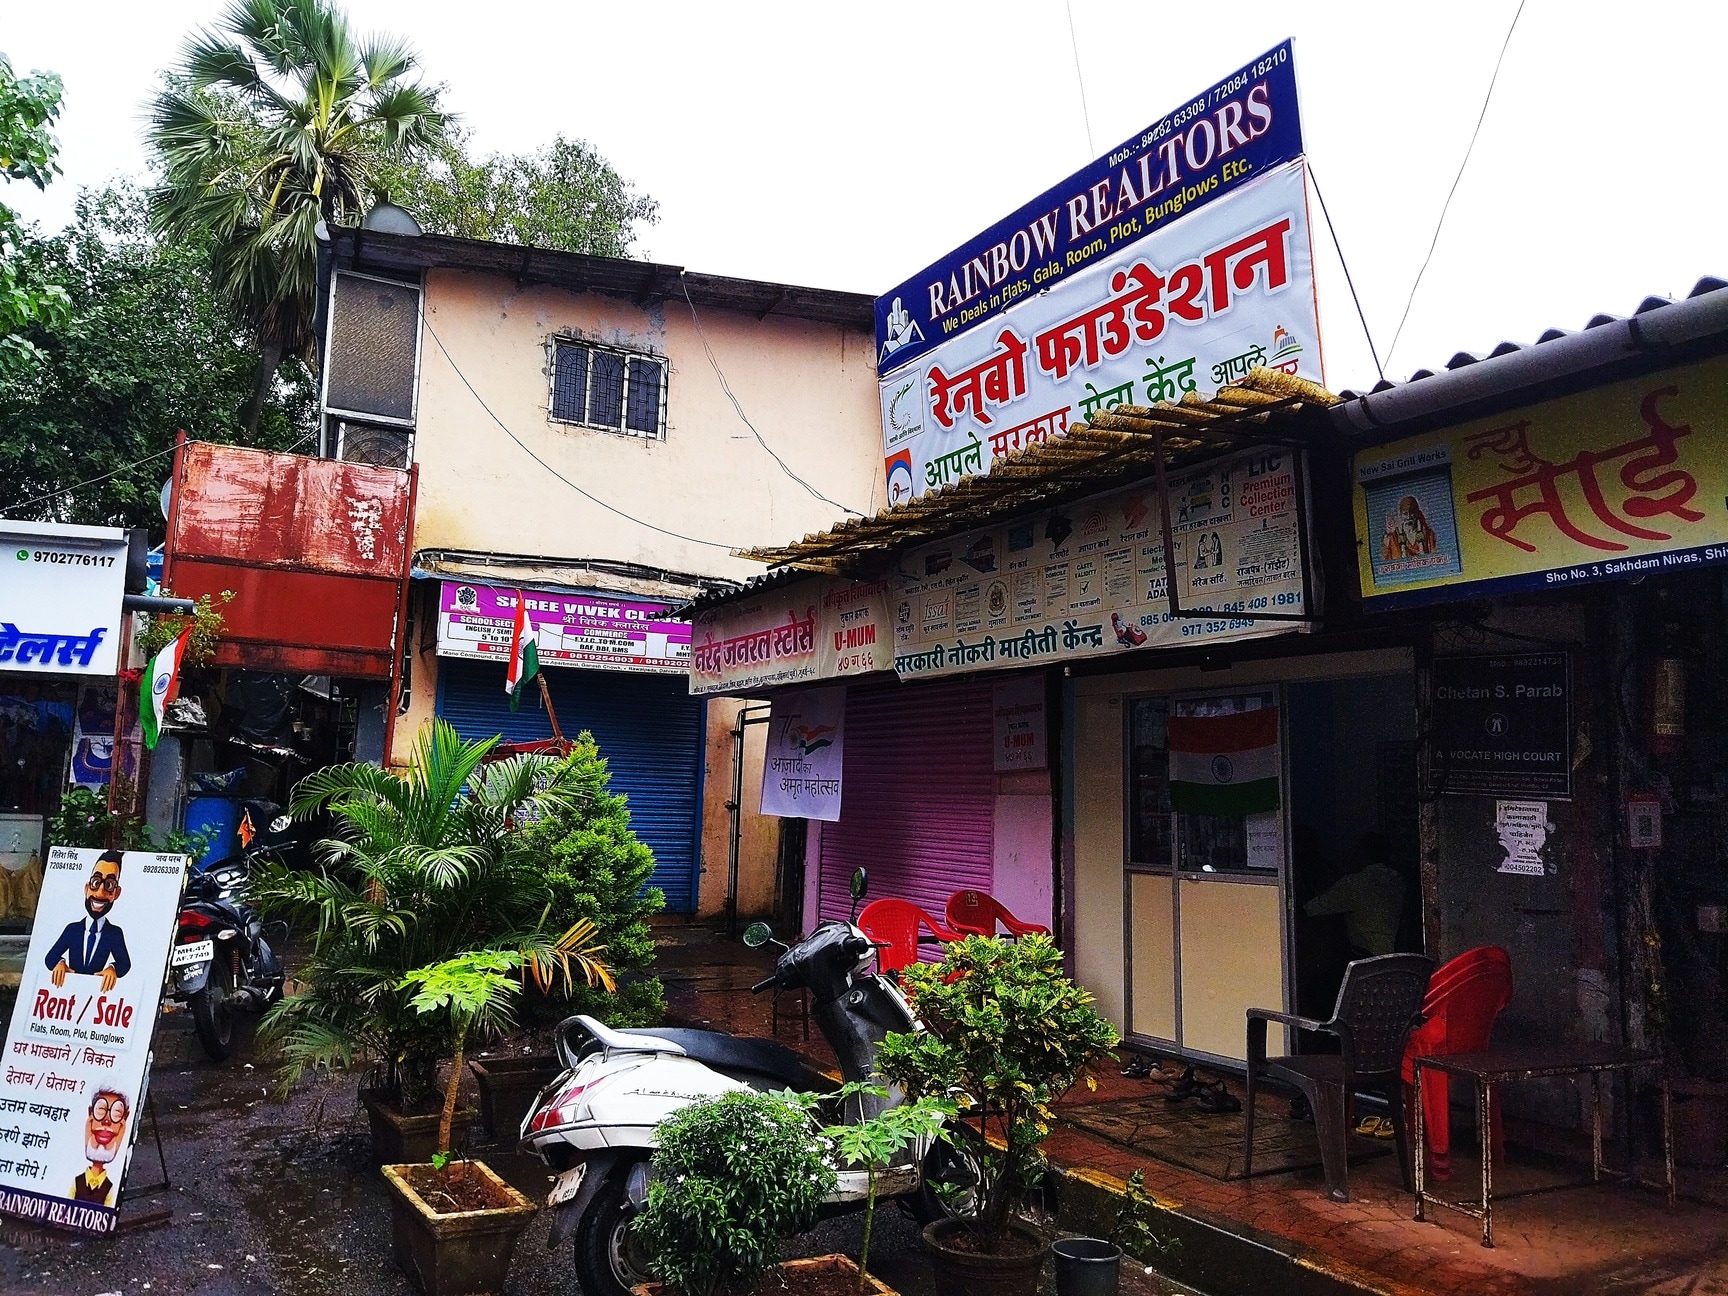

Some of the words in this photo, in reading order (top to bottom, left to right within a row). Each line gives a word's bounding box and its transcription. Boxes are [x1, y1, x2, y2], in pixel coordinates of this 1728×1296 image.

[1141, 120, 1172, 148] 89282
[1174, 98, 1206, 129] 63308
[1207, 94, 1213, 109] /
[1214, 72, 1249, 104] 72084
[1251, 48, 1288, 79] 18210
[928, 208, 1060, 321] RAINBOW
[1066, 82, 1274, 243] REALTORS
[942, 318, 959, 334] We
[961, 303, 988, 325] Deals
[990, 294, 1001, 309] in
[1002, 279, 1032, 304] Flats,
[1033, 261, 1065, 286] Gala,
[1066, 238, 1108, 267] Room,
[1110, 218, 1143, 244] Plot,
[1145, 173, 1219, 225] Bunglows
[1222, 156, 1253, 181] Etc.
[1036, 218, 1290, 377] फाउंडेशन
[925, 431, 983, 487] आपले
[1248, 453, 1282, 478] LIC
[1360, 466, 1380, 477] New
[1380, 461, 1396, 472] Sai
[1397, 454, 1416, 469] Grill
[1417, 449, 1448, 464] Works
[1466, 384, 1706, 553] साई
[1243, 473, 1291, 494] Premium
[1240, 485, 1295, 507] Collection
[1250, 500, 1286, 517] Center
[1142, 541, 1182, 556] Electrty
[33, 550, 116, 568] 9702776117
[1076, 561, 1093, 571] CASTE
[1546, 569, 1568, 583] Sho
[1571, 569, 1590, 580] No.
[1592, 566, 1603, 577] 3,
[1605, 556, 1660, 575] Sakhdam
[1663, 552, 1703, 567] Nivas,
[1074, 569, 1097, 579] VALIDITY
[1149, 577, 1169, 589] TAT
[1147, 587, 1169, 601] ADA
[1224, 602, 1245, 613] 845
[1248, 597, 1268, 609] 408
[1271, 591, 1301, 606] 1981
[563, 602, 621, 619] VIVEK
[1014, 612, 1042, 622] EMPLOYMENT
[460, 615, 496, 626] SCHOOL
[562, 614, 577, 625] श्री
[579, 616, 609, 628] विवेक
[611, 620, 649, 631] क्लासेस
[840, 611, 854, 629] दुकान
[1140, 614, 1160, 627] 885
[1182, 624, 1202, 636] 977
[1206, 620, 1226, 633] 352
[465, 625, 492, 634] ENGLISH
[496, 628, 512, 636] SEMI
[583, 628, 628, 639] COMMERCE
[694, 630, 722, 673] नरेंद्र
[723, 629, 772, 666] जनरल
[773, 604, 817, 657] स्टोर्स
[834, 623, 876, 651] U-MUM
[569, 652, 634, 664] 9819254903
[612, 646, 629, 654] BMS
[895, 643, 945, 675] सरकारी
[947, 635, 996, 667] नोकरी
[999, 625, 1057, 660] माहीती
[1437, 686, 1490, 699] Chetan
[1494, 685, 1510, 698] S.
[1515, 683, 1563, 698] Parab
[1004, 732, 1035, 748] U-MUM
[1493, 751, 1520, 761] HIGH
[1522, 751, 1562, 762] COURT
[803, 763, 813, 774] का
[780, 778, 803, 800] अमृत
[804, 773, 840, 798] महोत्सव
[49, 861, 83, 871] 7208418210
[142, 865, 180, 875] 8928263308
[33, 989, 76, 1021] Rent
[76, 995, 93, 1025] /
[93, 995, 134, 1029] Sale
[30, 1023, 48, 1037] Flats,
[49, 1027, 72, 1040] Room,
[72, 1029, 88, 1041] Plot,
[90, 1032, 125, 1045] Bunglows
[13, 1041, 28, 1057] घर
[71, 1048, 82, 1066] /
[82, 1046, 116, 1069] विकत
[5, 1065, 36, 1087] देताय
[35, 1072, 46, 1090] /
[45, 1072, 78, 1093] घेताय
[79, 1080, 86, 1095] ?
[0, 1098, 28, 1114] उत्तम
[29, 1102, 71, 1122] व्यवहार
[21, 1130, 51, 1149] झाले
[15, 1158, 40, 1179] सोपे
[41, 1164, 48, 1181] !
[47, 1201, 110, 1233] REALTORS
